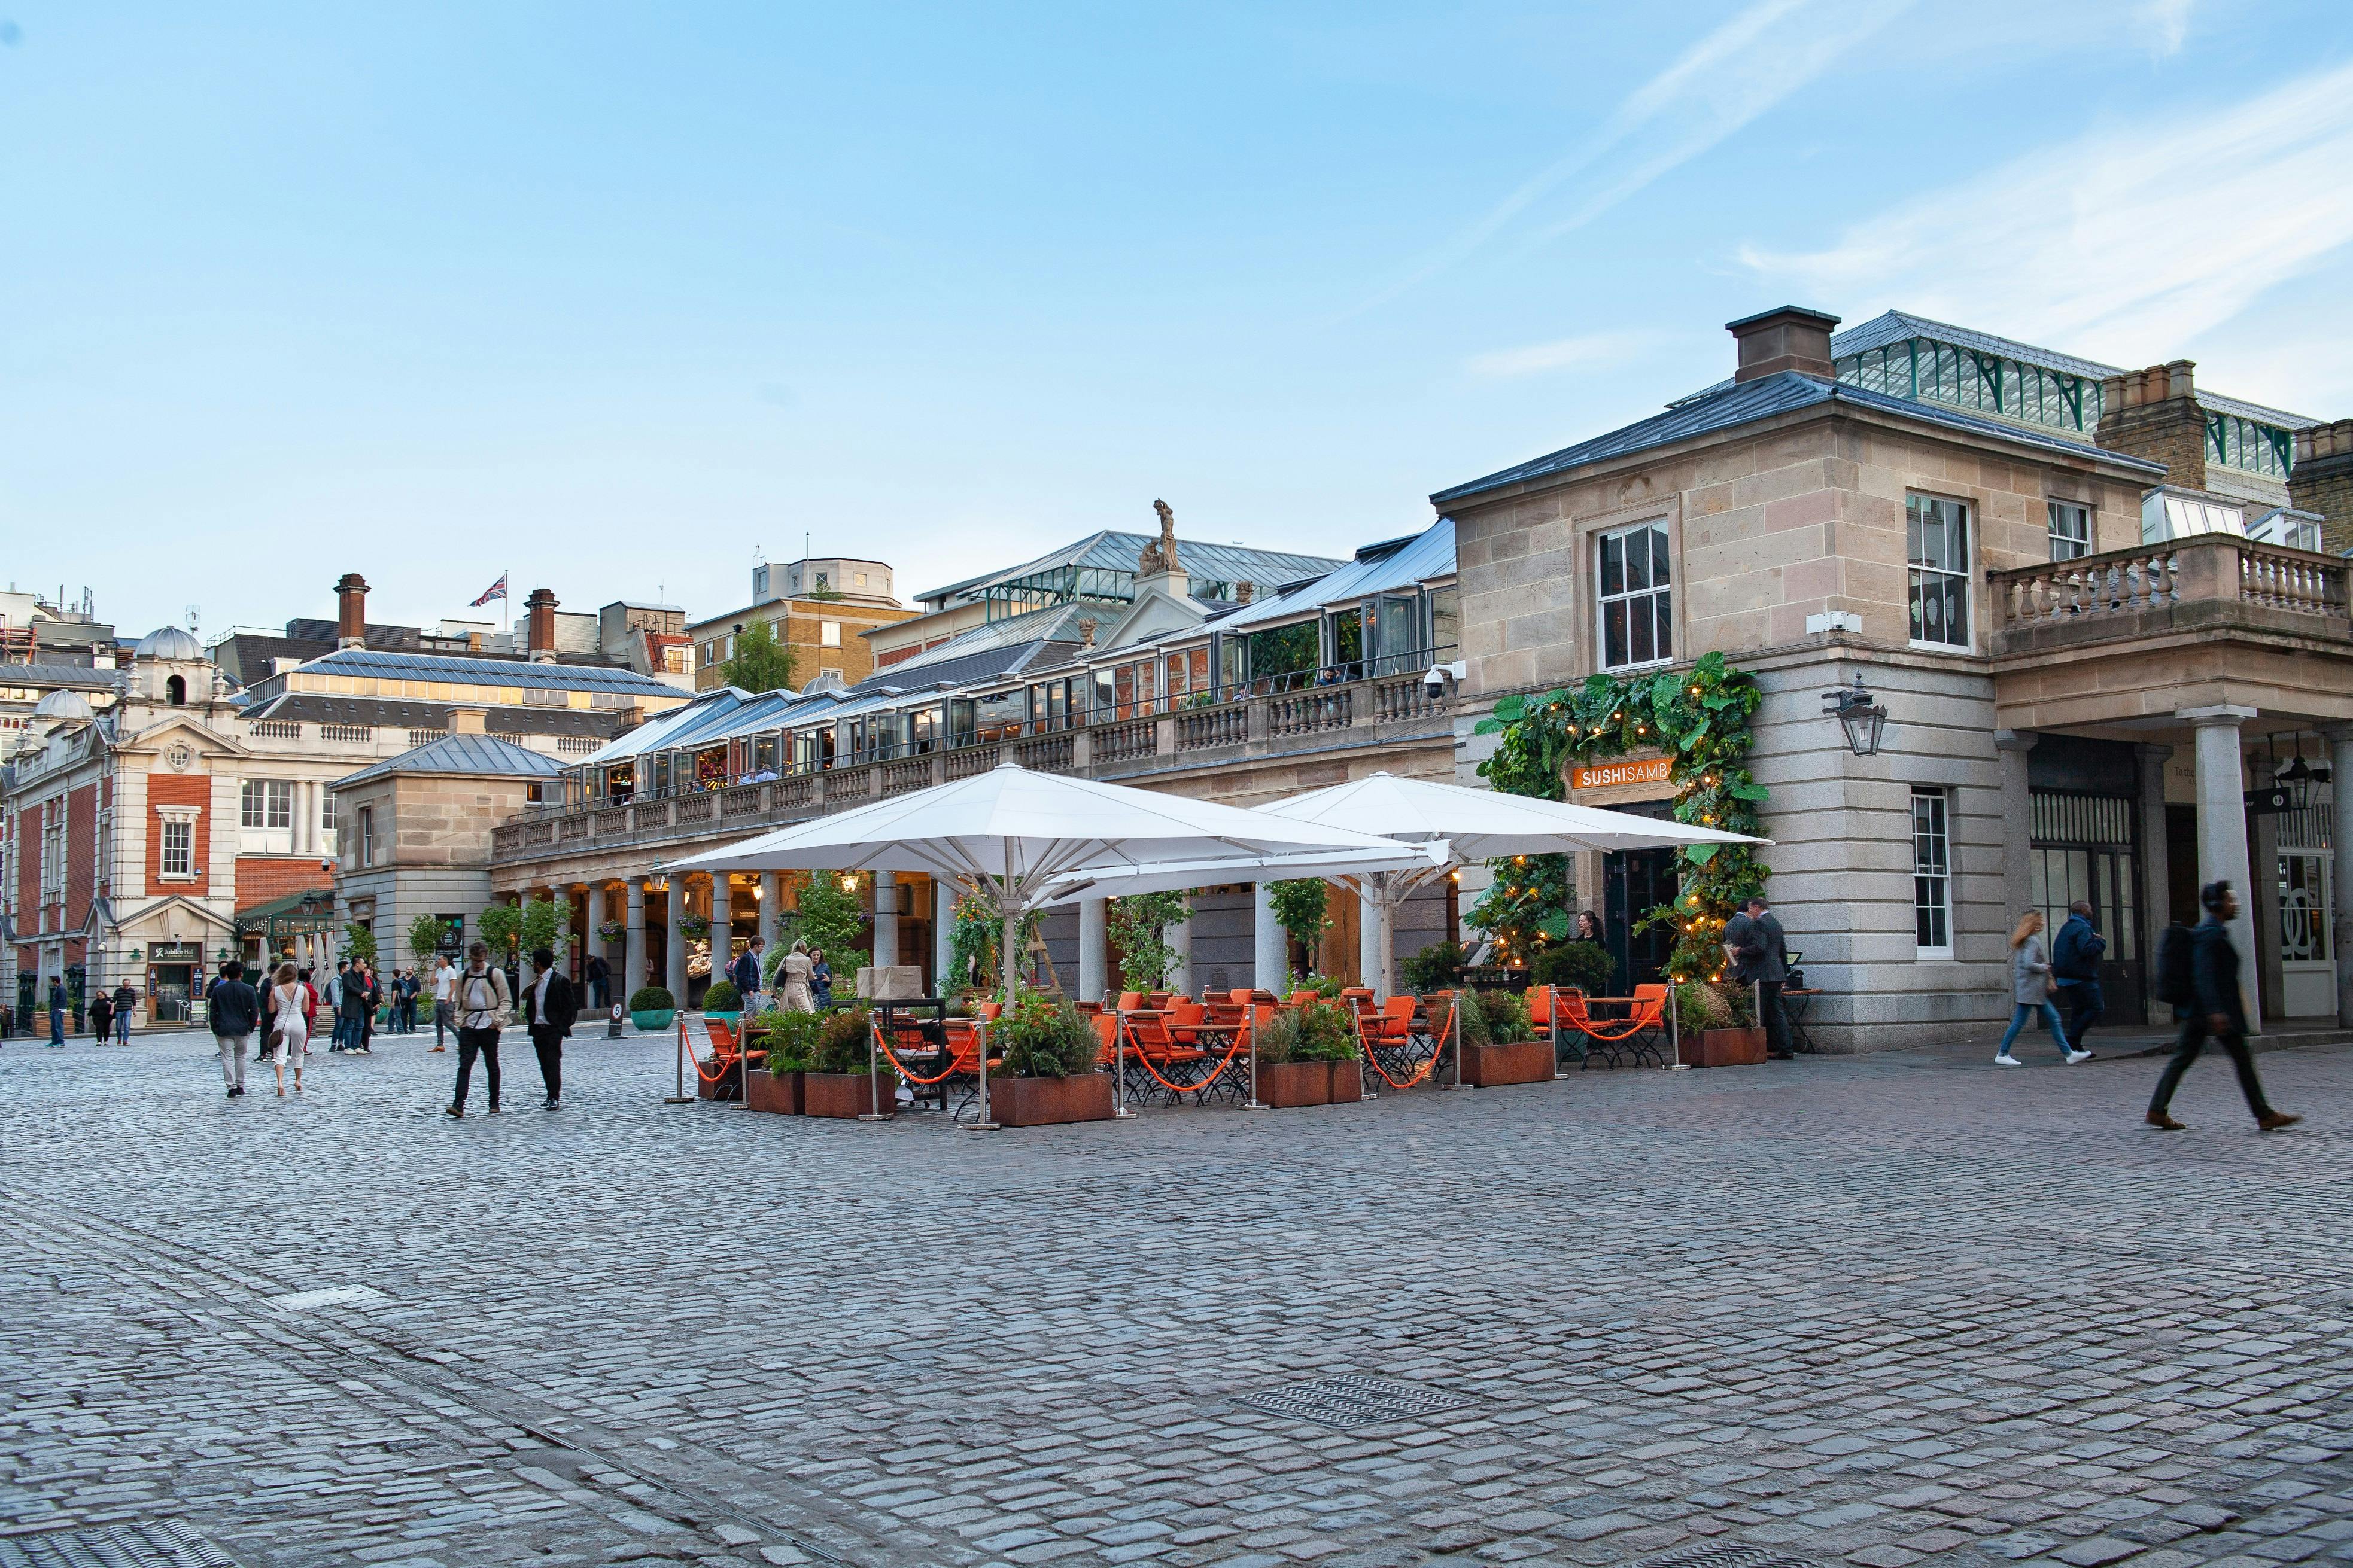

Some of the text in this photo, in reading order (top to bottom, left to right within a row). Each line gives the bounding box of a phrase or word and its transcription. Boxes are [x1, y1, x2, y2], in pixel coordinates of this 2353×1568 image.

[1582, 763, 1672, 786] SUSHISAMB
[2174, 766, 2194, 777] To the
[615, 1006, 619, 1015] 5
